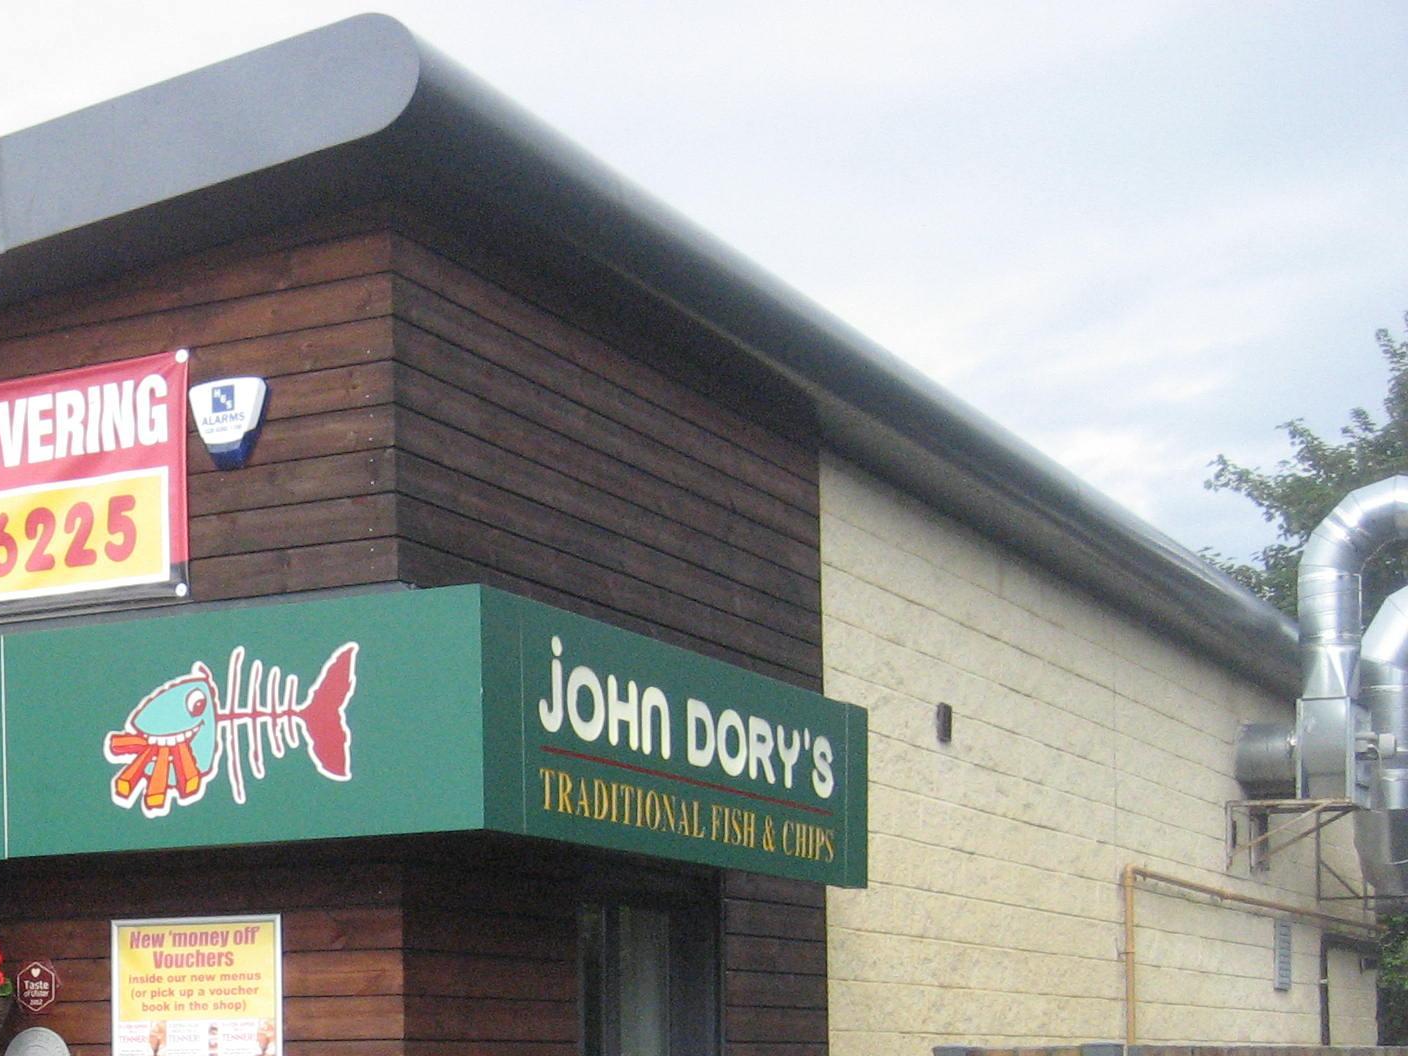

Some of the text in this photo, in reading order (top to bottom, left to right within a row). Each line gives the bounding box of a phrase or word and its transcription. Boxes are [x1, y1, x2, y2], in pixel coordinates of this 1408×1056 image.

[201, 412, 245, 426] ALARMS
[687, 698, 835, 799] DORY'S
[539, 767, 835, 863] TRADITIONAL FISH & CHIPS
[130, 931, 165, 949] New
[152, 950, 235, 969] Vouchers
[23, 980, 49, 990] Taste
[128, 972, 261, 984] inside our new menus
[130, 985, 259, 1000] (or pick up a voucher
[142, 1000, 247, 1012] book in the shop)
